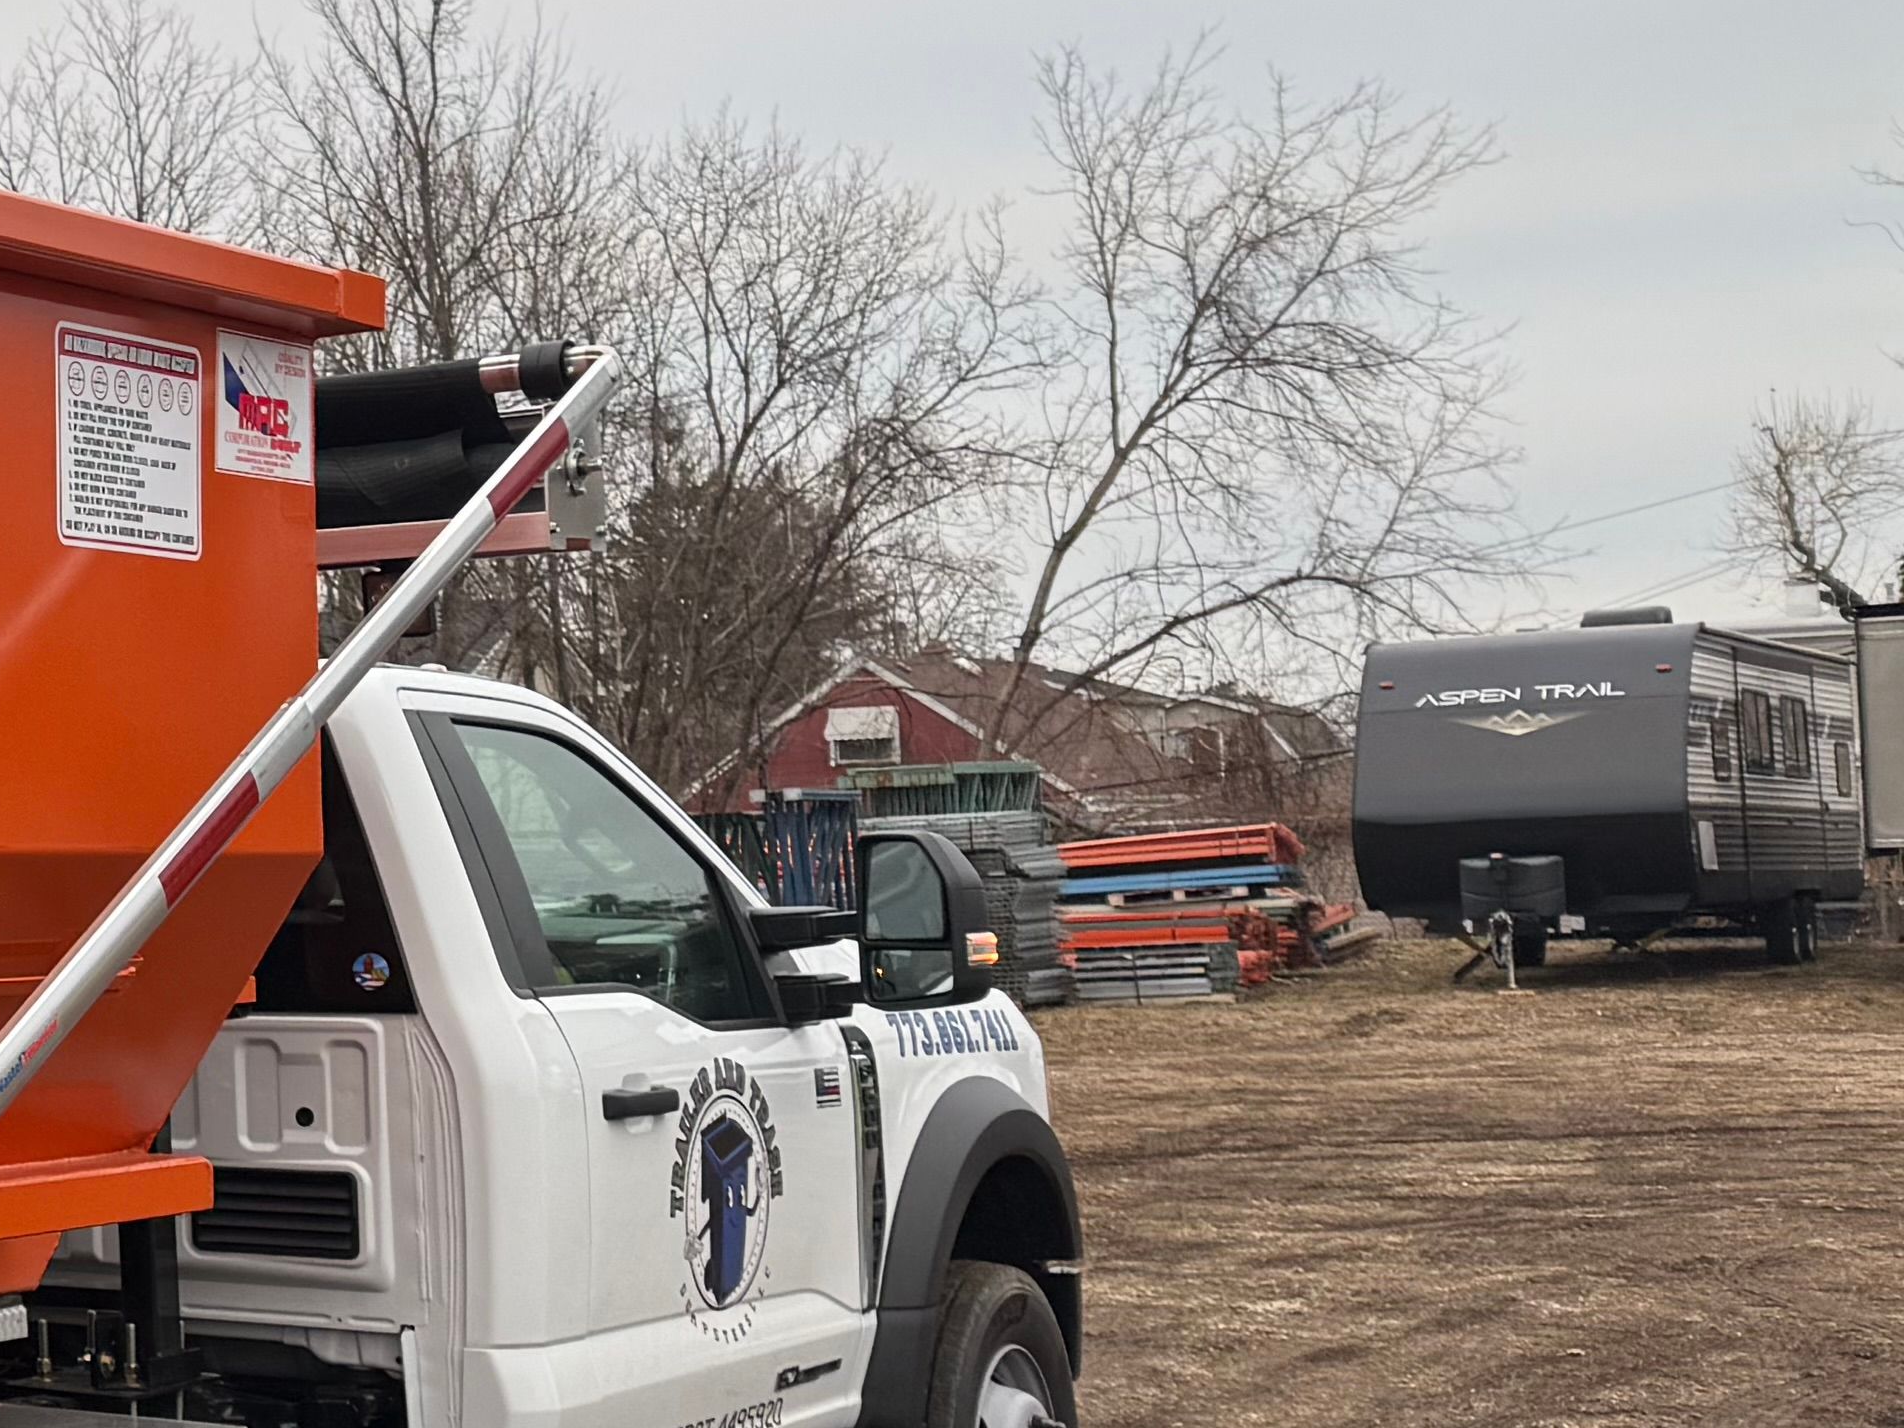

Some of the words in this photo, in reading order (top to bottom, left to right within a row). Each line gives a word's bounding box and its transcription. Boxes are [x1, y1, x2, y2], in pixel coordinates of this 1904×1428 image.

[238, 392, 289, 438] MAC
[1413, 686, 1521, 708] ASPEN
[1533, 681, 1626, 701] TRAIL
[885, 1009, 1019, 1058] 773.861.7411
[670, 1066, 714, 1218] TRAILER
[714, 1056, 746, 1096] AND
[749, 1076, 783, 1200] TRASH
